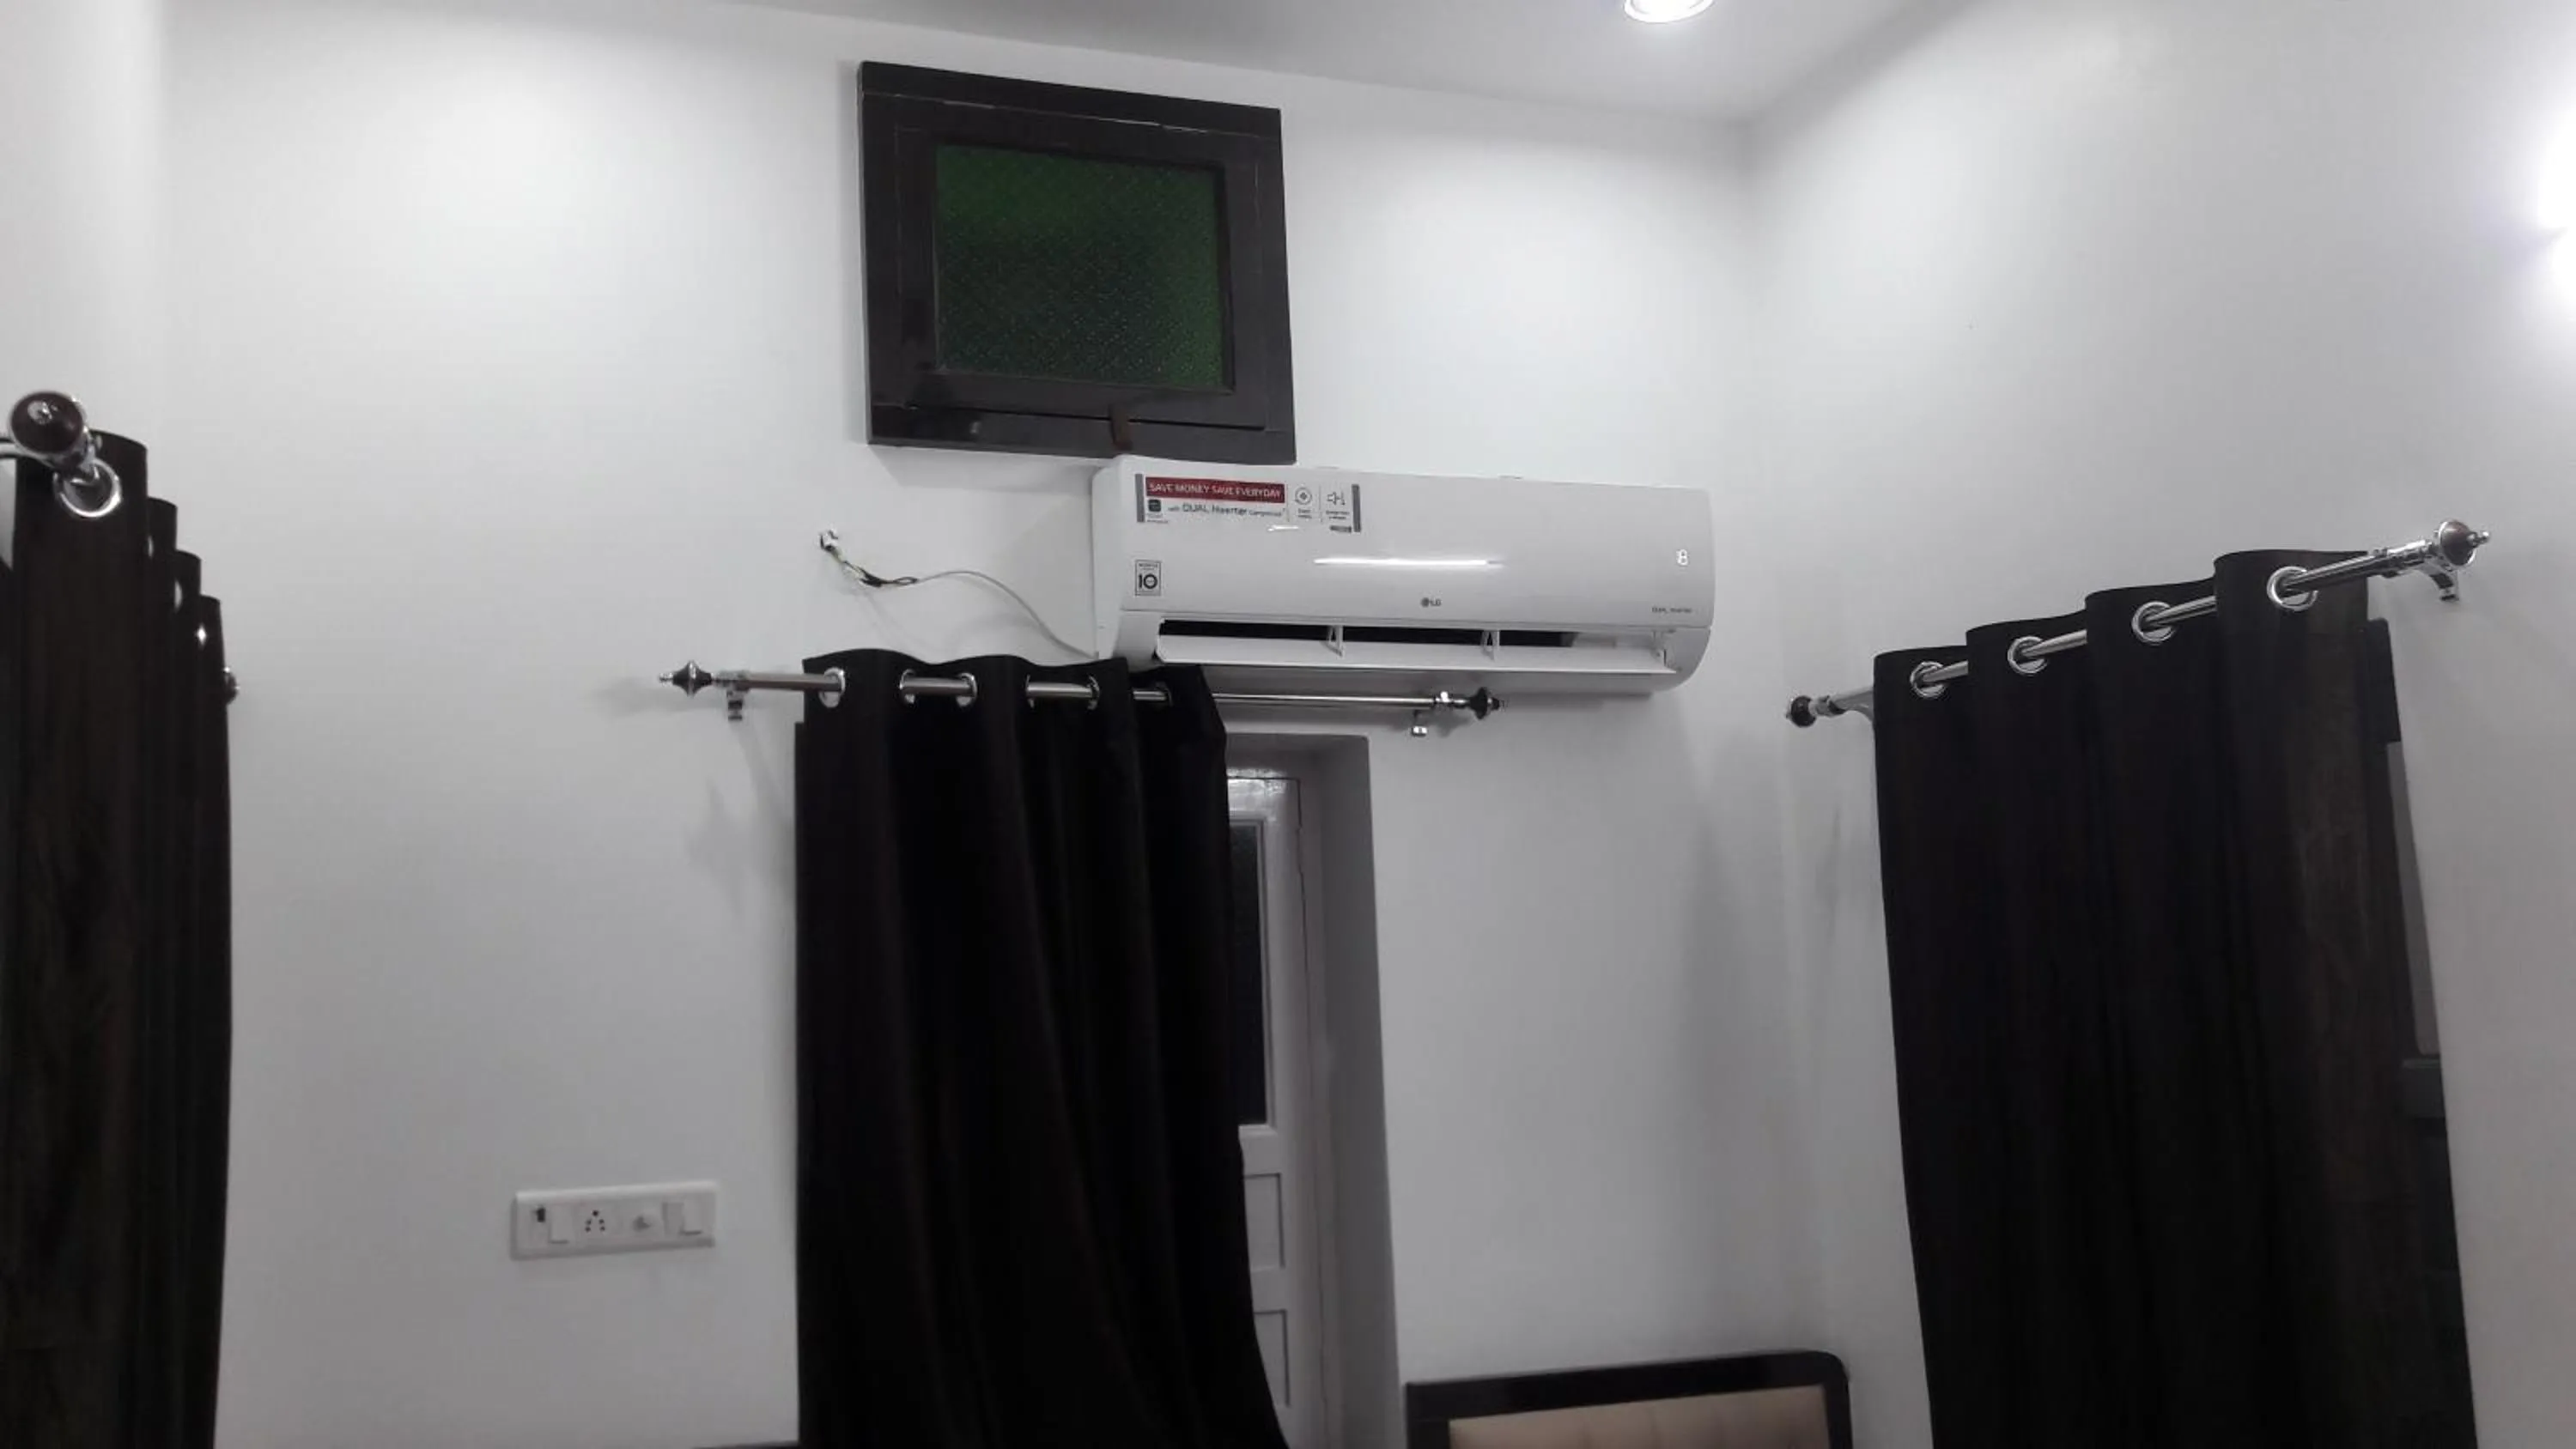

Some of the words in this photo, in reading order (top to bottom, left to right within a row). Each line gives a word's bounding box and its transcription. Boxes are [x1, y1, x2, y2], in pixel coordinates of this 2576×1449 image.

[1149, 483, 1173, 492] SAVE
[1175, 484, 1210, 494] MONEY
[1212, 486, 1235, 495] SAVE
[1236, 488, 1281, 498] EVERYDAY
[1182, 502, 1209, 514] DUAL
[1139, 573, 1158, 590] 10
